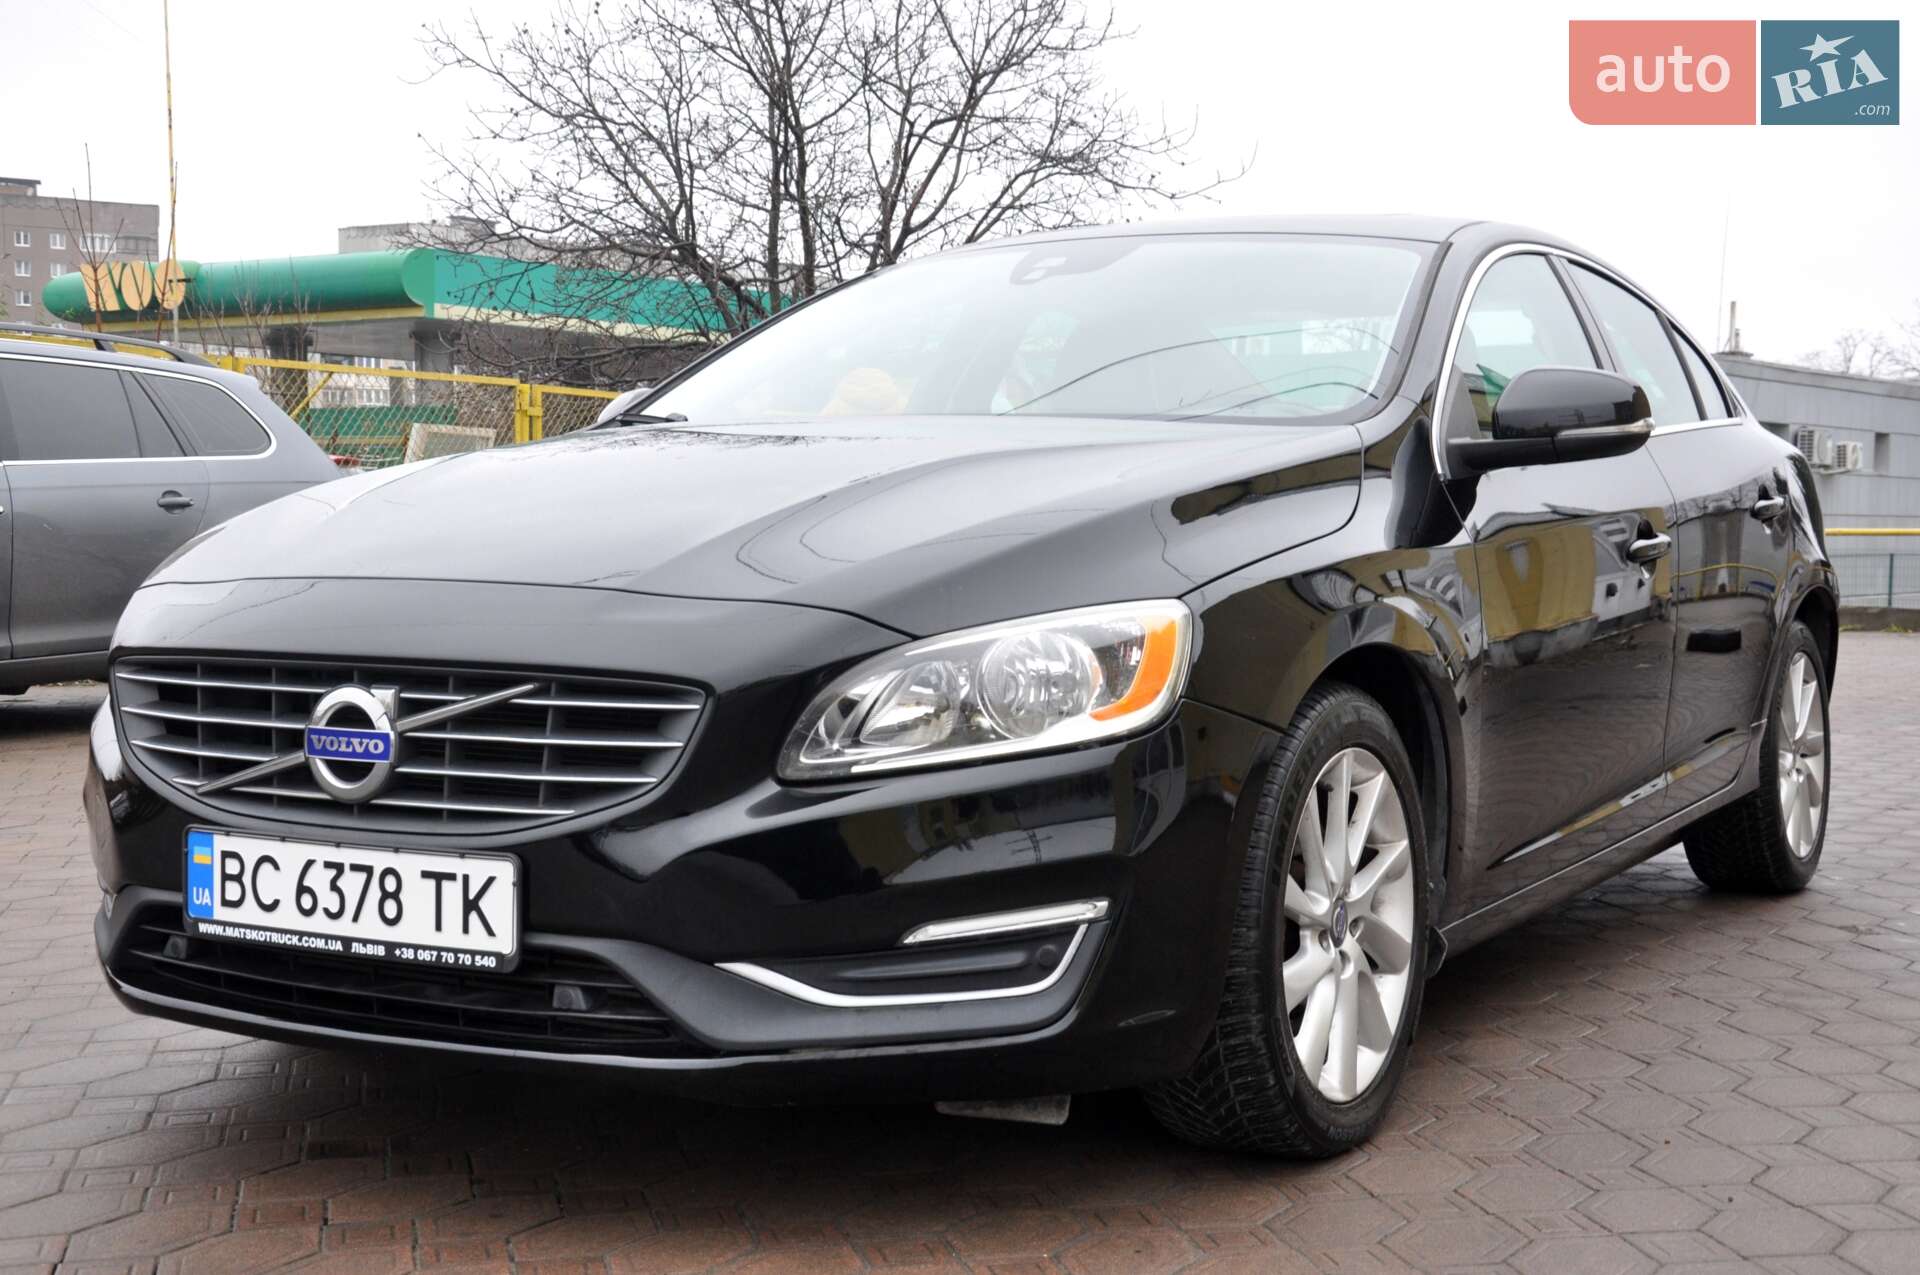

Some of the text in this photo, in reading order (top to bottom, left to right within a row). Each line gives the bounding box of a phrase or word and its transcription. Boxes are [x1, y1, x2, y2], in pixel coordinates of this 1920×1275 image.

[310, 734, 385, 754] VOLVO
[192, 887, 212, 907] UA
[220, 850, 497, 938] BC 6378 TK
[198, 922, 344, 952] WWW.MATSKOTRUCK.COM.UA
[394, 948, 415, 960] +38
[417, 949, 438, 962] 067
[440, 952, 455, 964] 70
[457, 953, 472, 965] 70
[474, 955, 496, 968] 540
